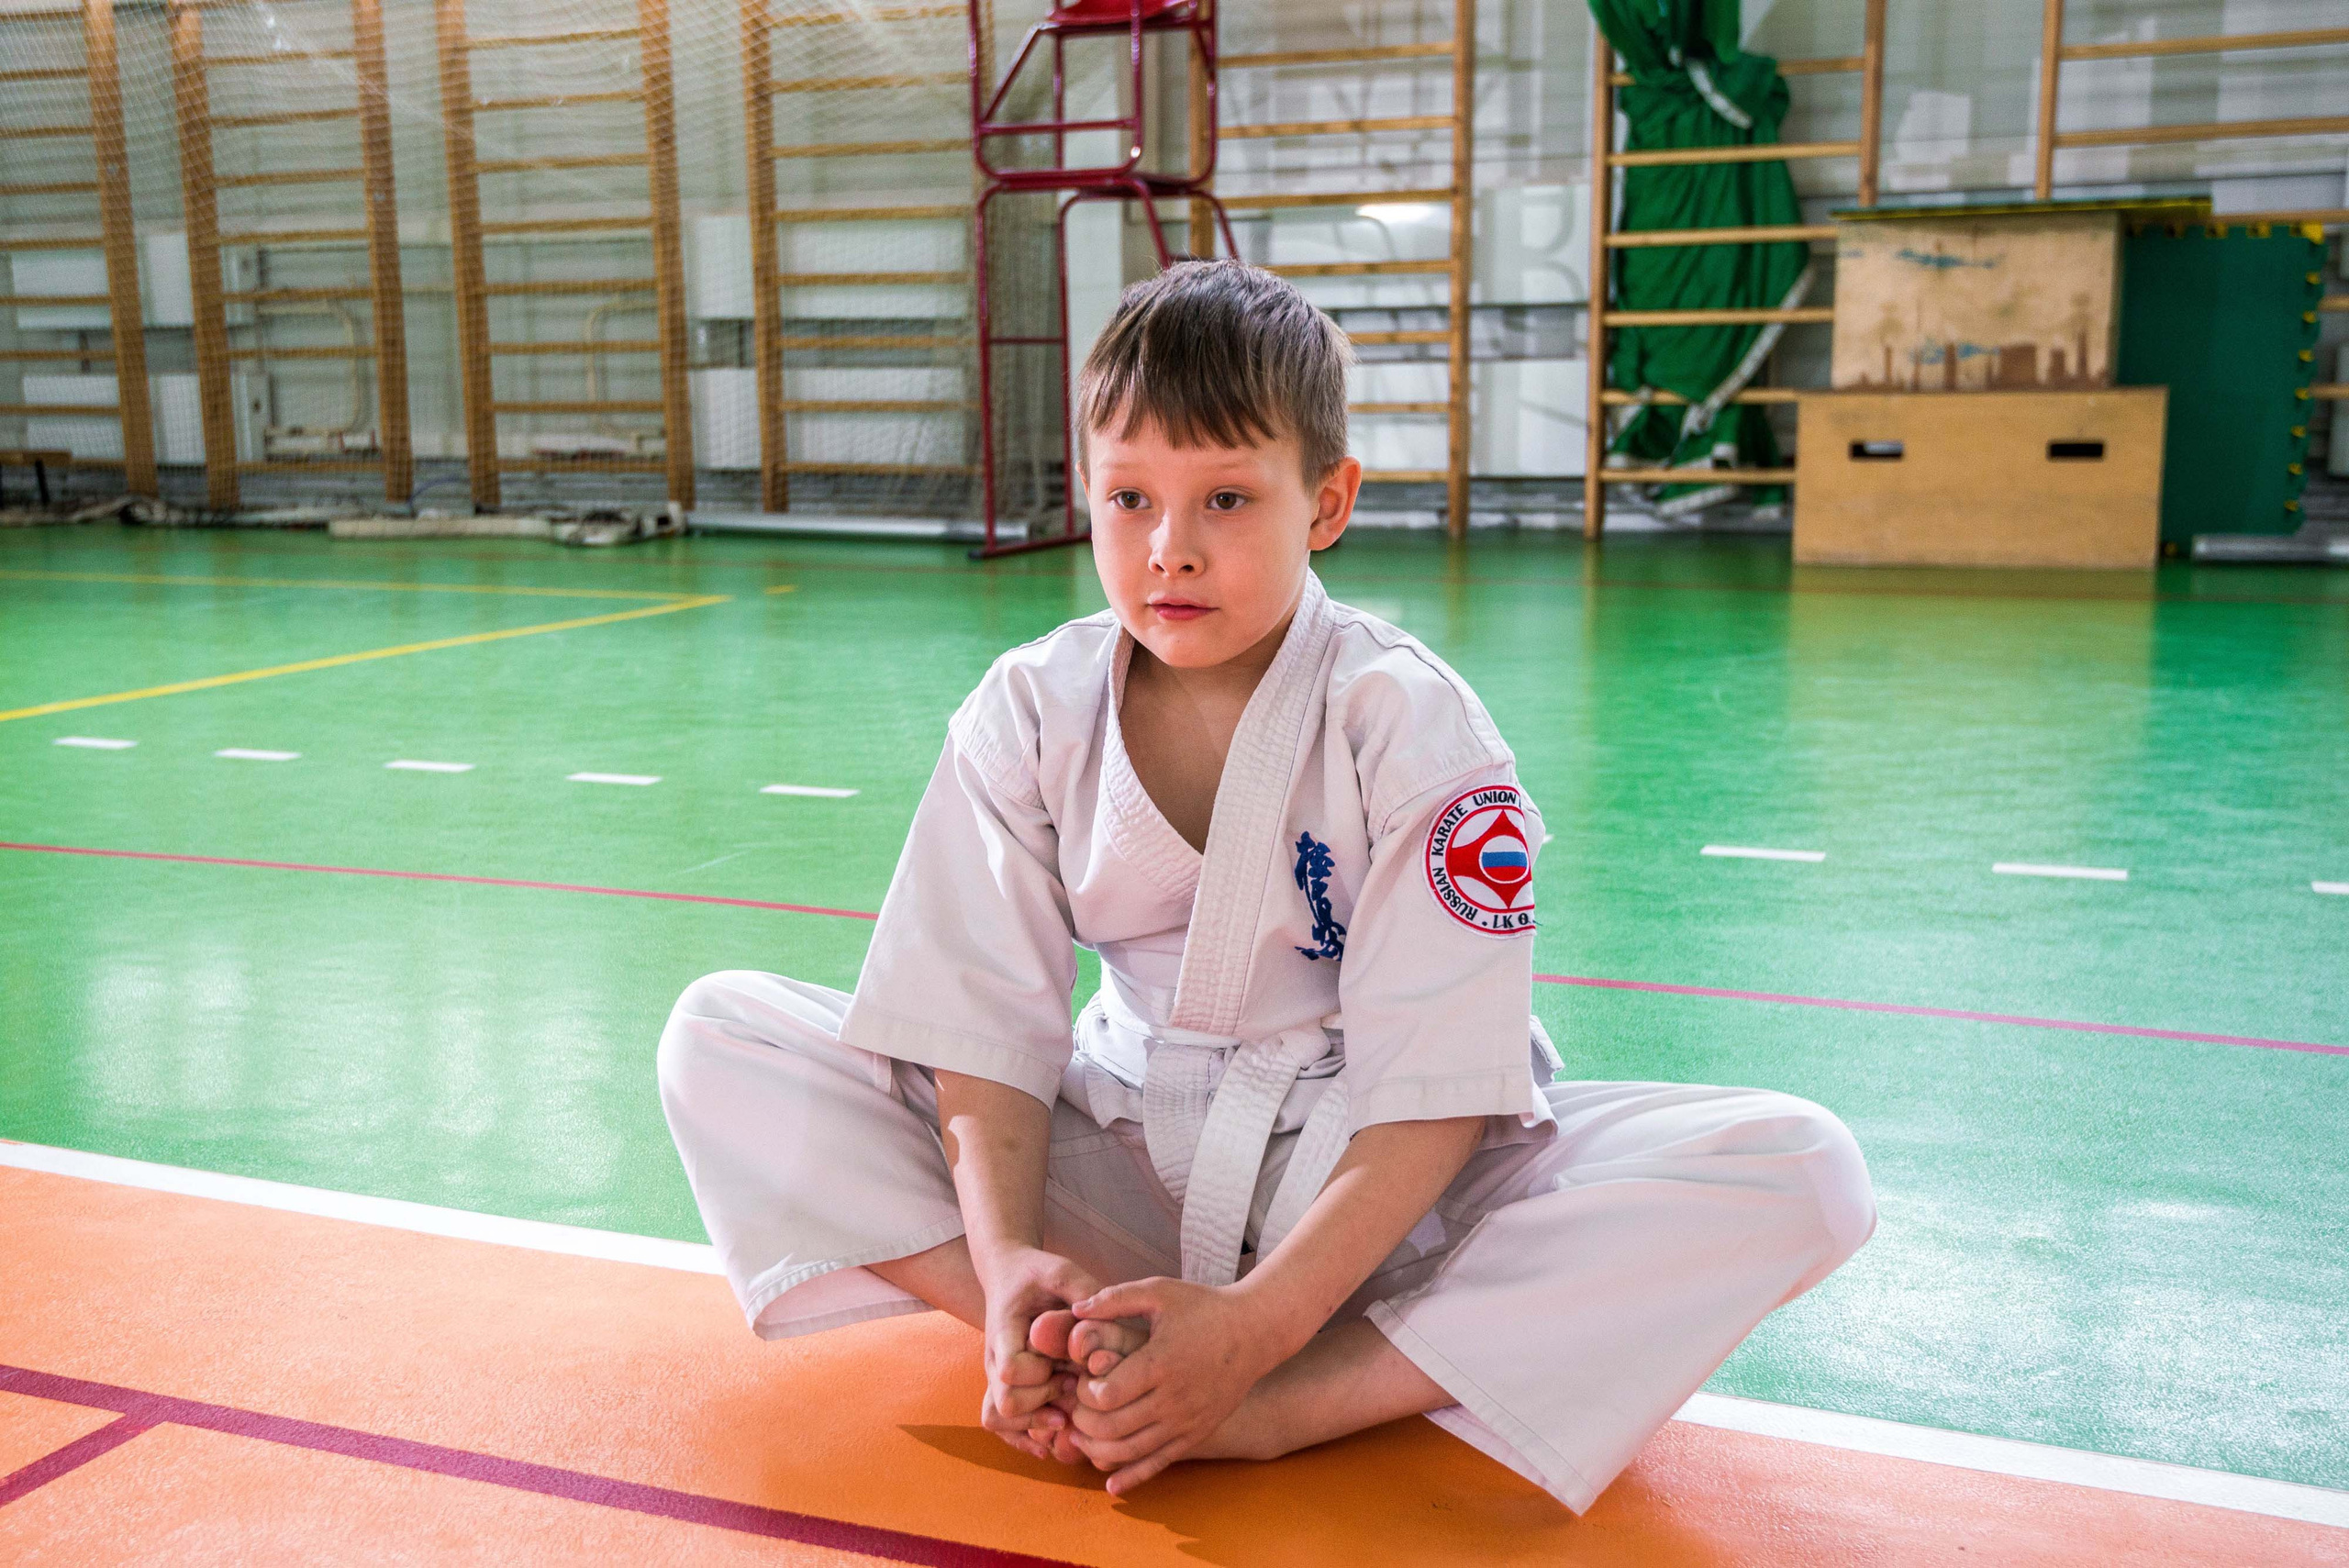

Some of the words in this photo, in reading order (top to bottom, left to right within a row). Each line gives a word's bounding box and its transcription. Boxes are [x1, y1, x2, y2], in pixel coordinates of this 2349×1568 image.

[1473, 791, 1517, 806] UNION
[1431, 804, 1468, 856] KARATE
[1432, 867, 1478, 921] RUSSIAN
